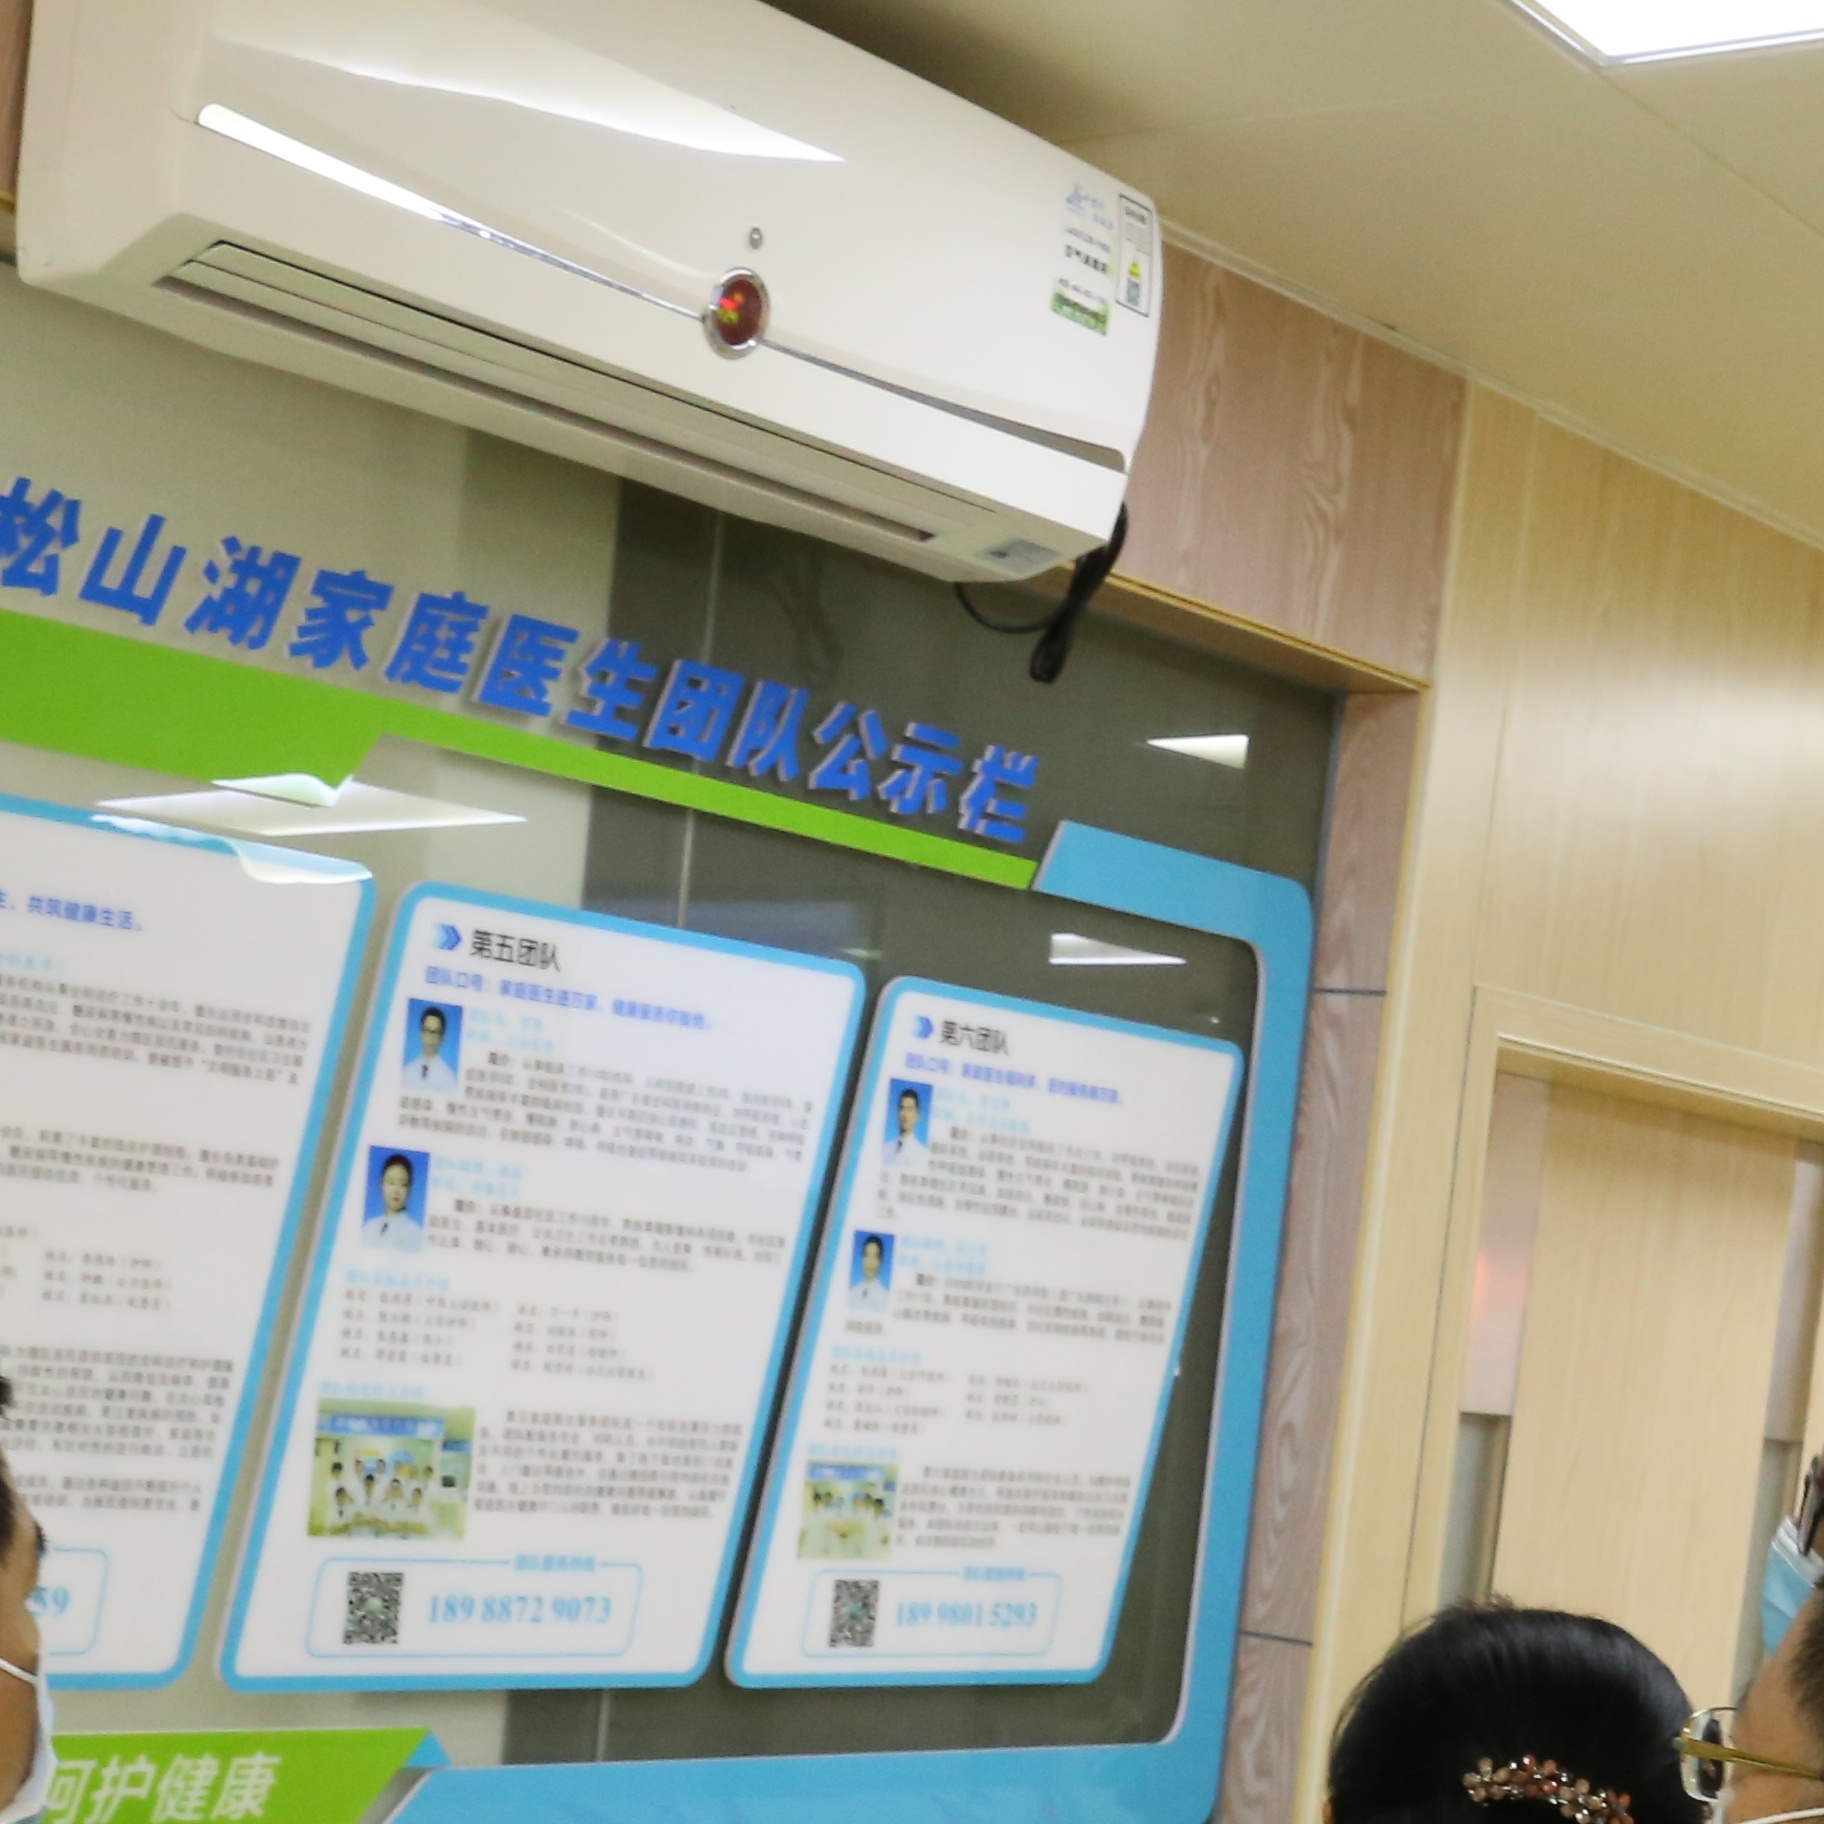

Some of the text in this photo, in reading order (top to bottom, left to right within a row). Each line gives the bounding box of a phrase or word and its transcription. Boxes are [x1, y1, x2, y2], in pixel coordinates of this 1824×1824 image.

[470, 928, 562, 973] 第五团队
[939, 1019, 1009, 1057] 第六团队
[429, 1594, 475, 1623] 189
[481, 1594, 545, 1623] 8872
[897, 1602, 932, 1627] 189
